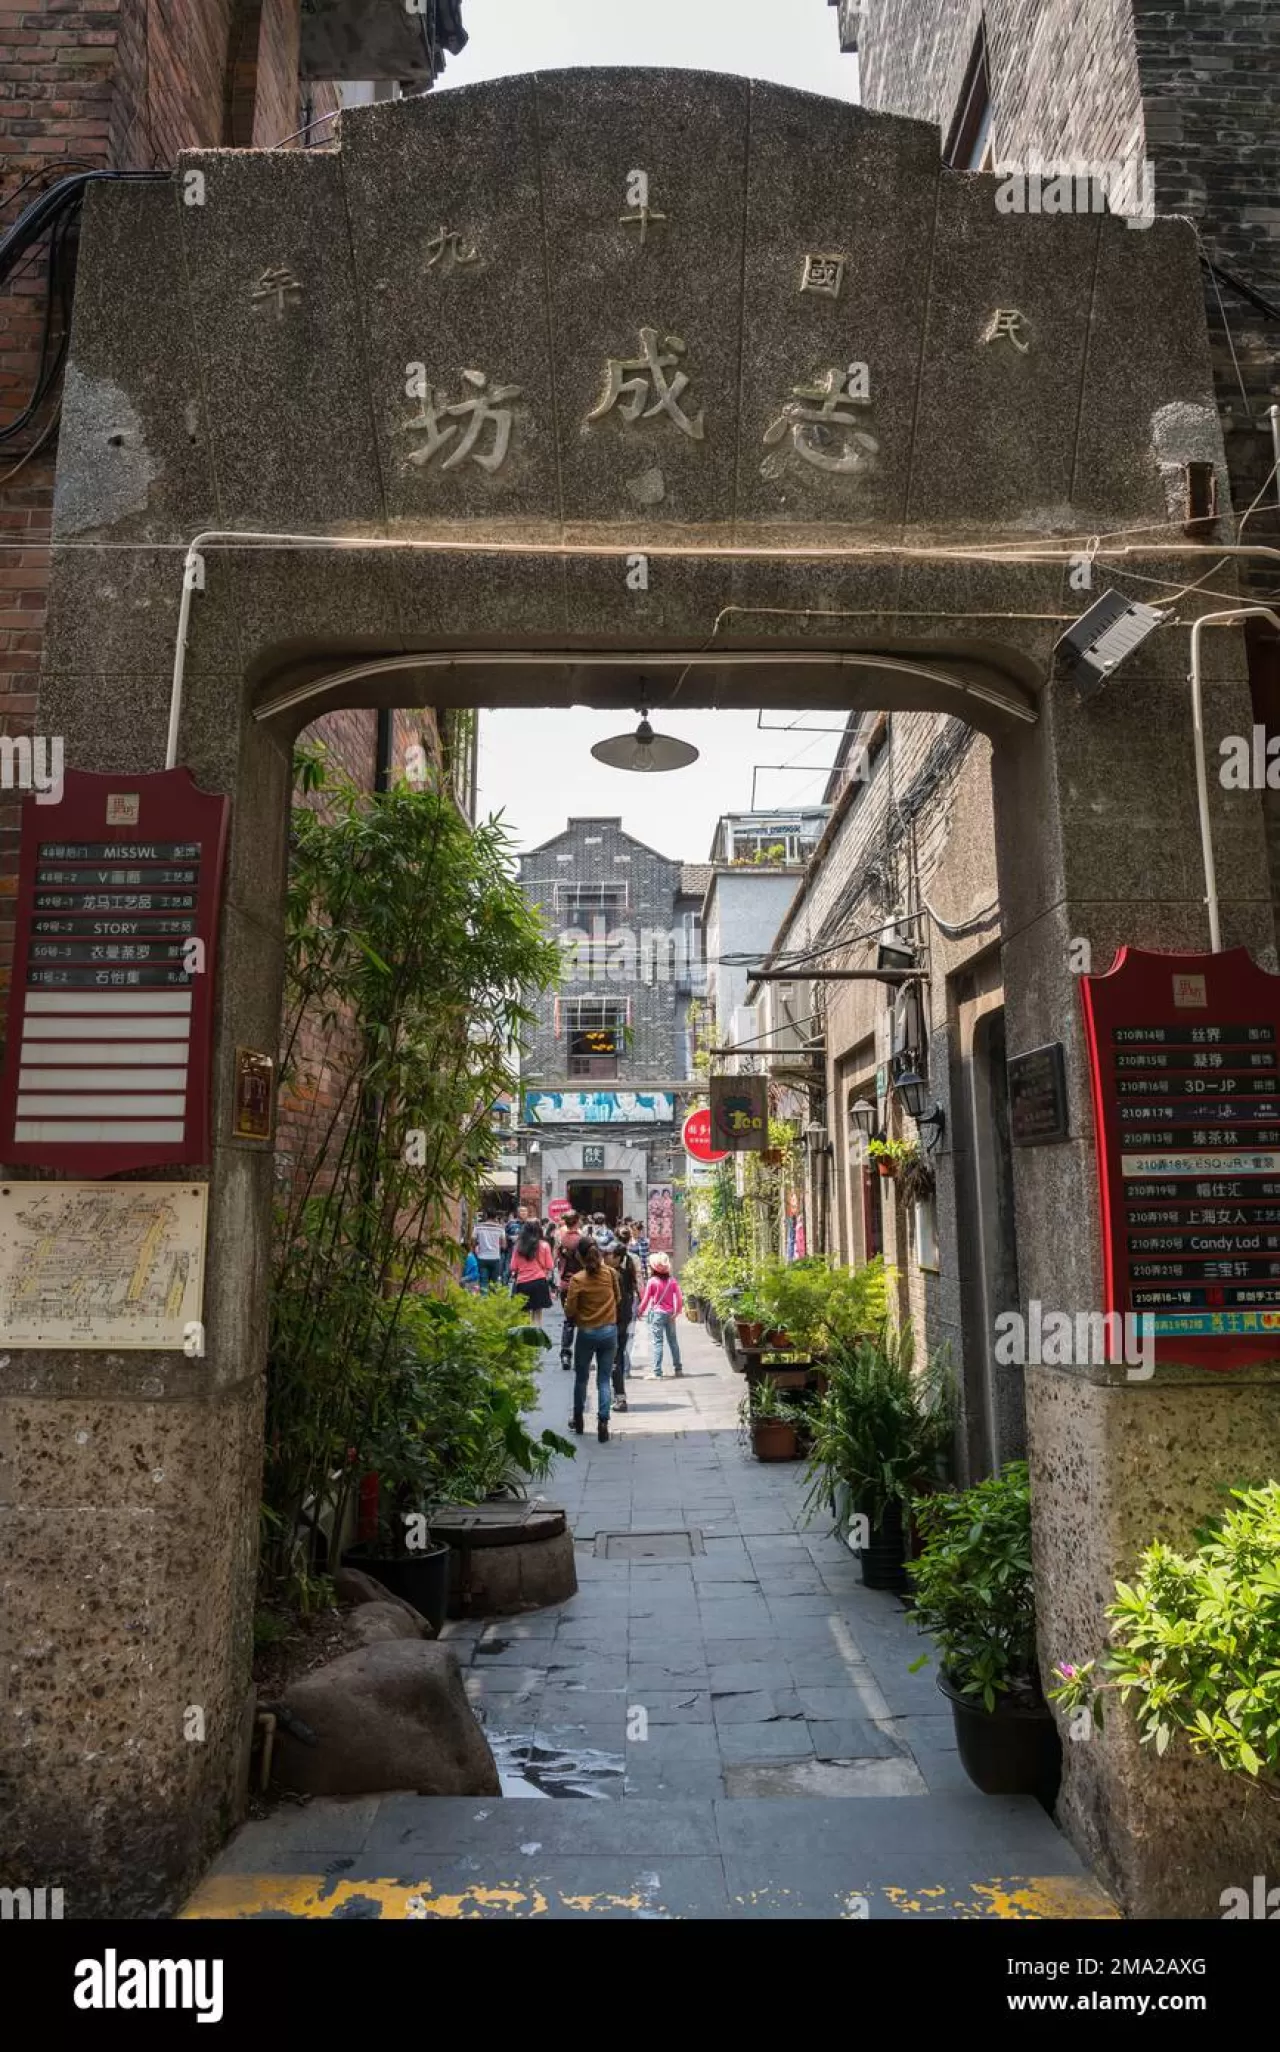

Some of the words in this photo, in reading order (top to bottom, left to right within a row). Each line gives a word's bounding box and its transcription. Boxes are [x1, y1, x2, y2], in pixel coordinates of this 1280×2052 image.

[103, 847, 159, 859] MISSWL
[82, 894, 152, 910] 龙马工艺品
[93, 922, 138, 935] STORY
[1186, 1208, 1247, 1225] 上海女人
[1190, 1236, 1232, 1251] Candy
